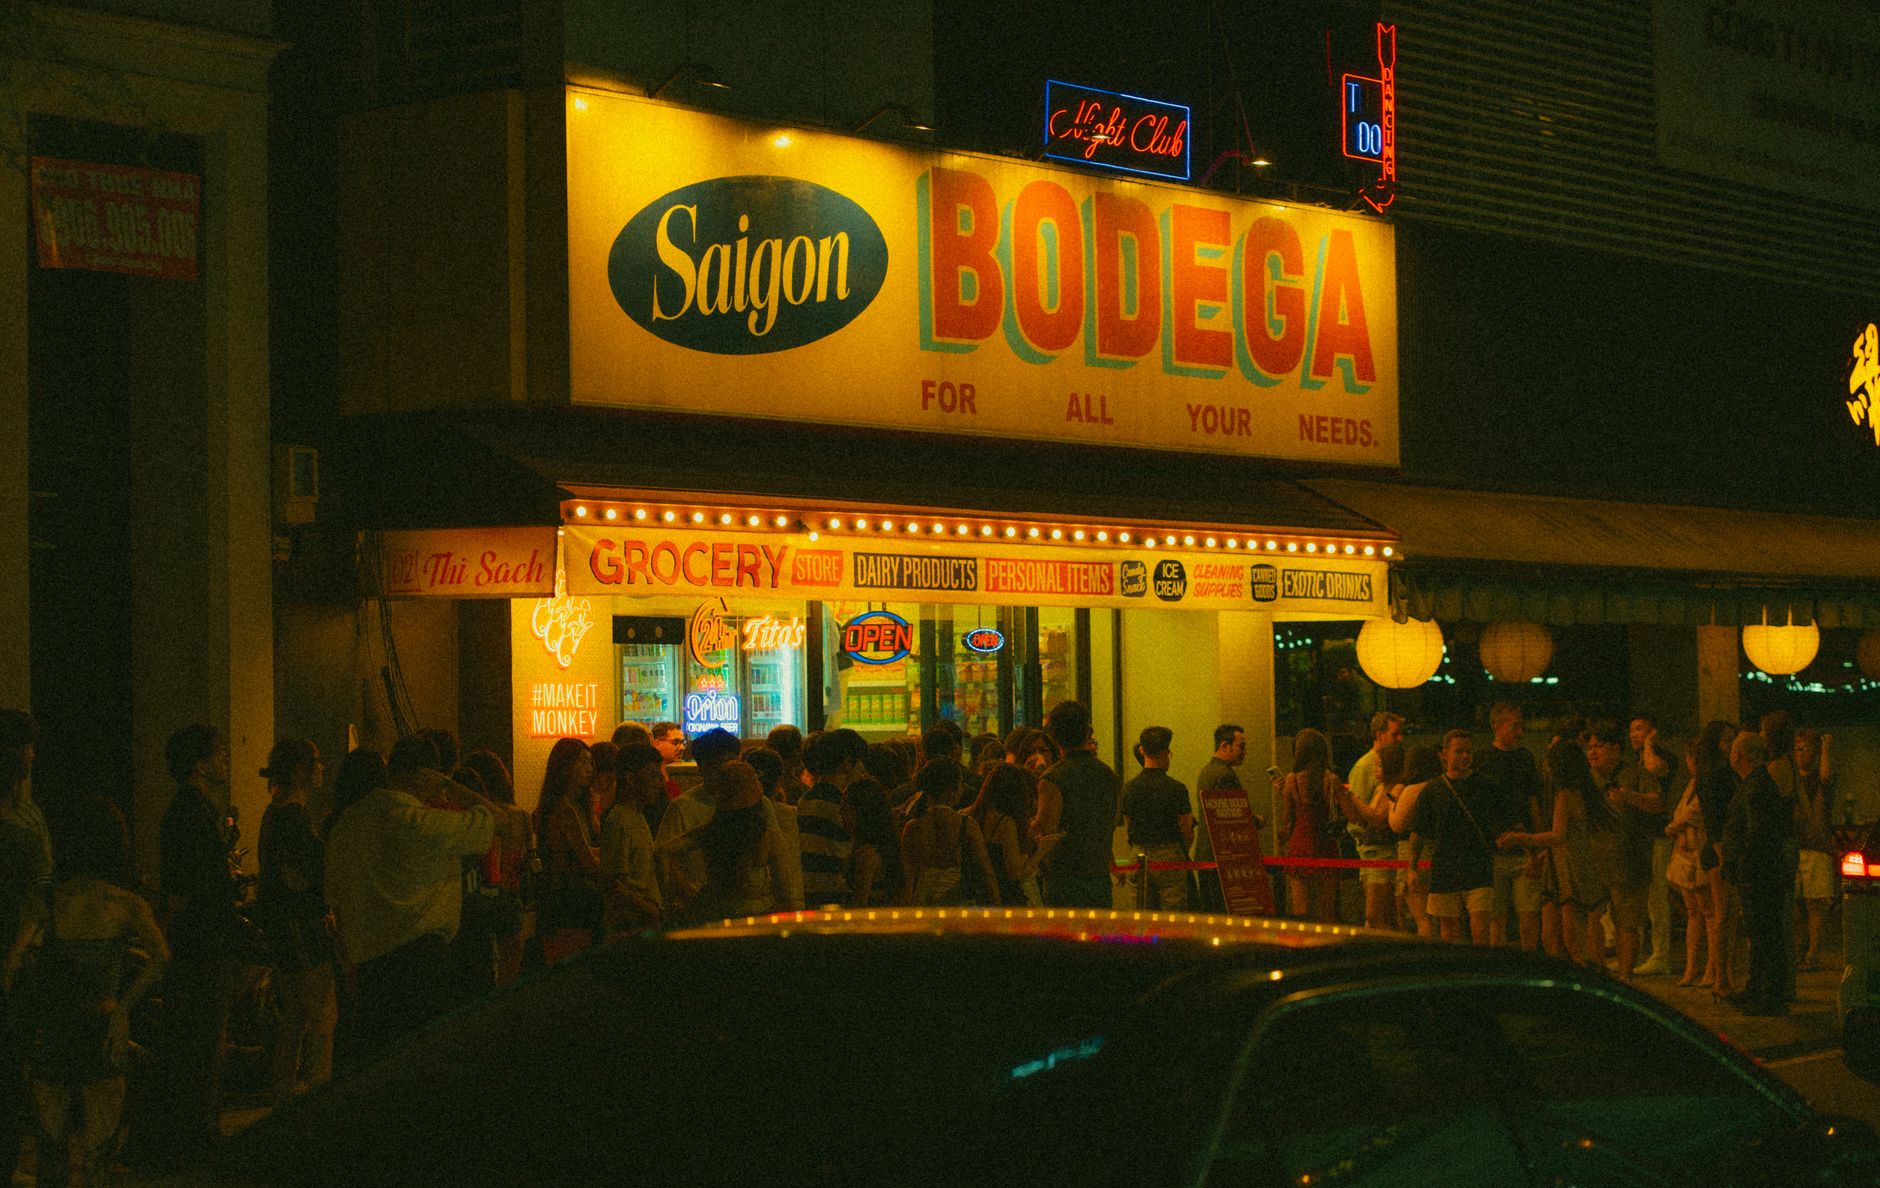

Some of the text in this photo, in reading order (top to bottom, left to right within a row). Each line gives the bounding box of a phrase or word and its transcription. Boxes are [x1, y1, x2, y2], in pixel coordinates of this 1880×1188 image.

[1050, 99, 1187, 159] Night Club
[1384, 67, 1393, 175] DANCING
[652, 203, 850, 337] Saigon
[916, 166, 1377, 394] BODEGA
[921, 379, 1378, 447] FOR ALL YOUR NEEDS.
[423, 551, 469, 588] Thi
[474, 549, 545, 587] Sach
[589, 538, 840, 588] GROCERY STORE
[856, 554, 976, 591] DAIRY PRODUCTS
[988, 560, 1110, 594] PERSONAL ITEMS
[1122, 562, 1146, 582] Candy
[1162, 563, 1179, 578] ICE
[1193, 563, 1244, 581] CLEANING
[1252, 568, 1277, 582] CANNED
[1156, 581, 1184, 597] CREAM
[1193, 582, 1243, 598] SUPPLIES
[1254, 584, 1276, 599] GOODS
[1284, 570, 1370, 600] EXOTIC DRINKS
[743, 615, 805, 650] Tito's
[844, 624, 913, 652] OPEN
[972, 633, 1000, 648] OPEN
[531, 683, 598, 708] #MAKEIT
[686, 690, 738, 721] Orion
[532, 710, 598, 736] MONKEY
